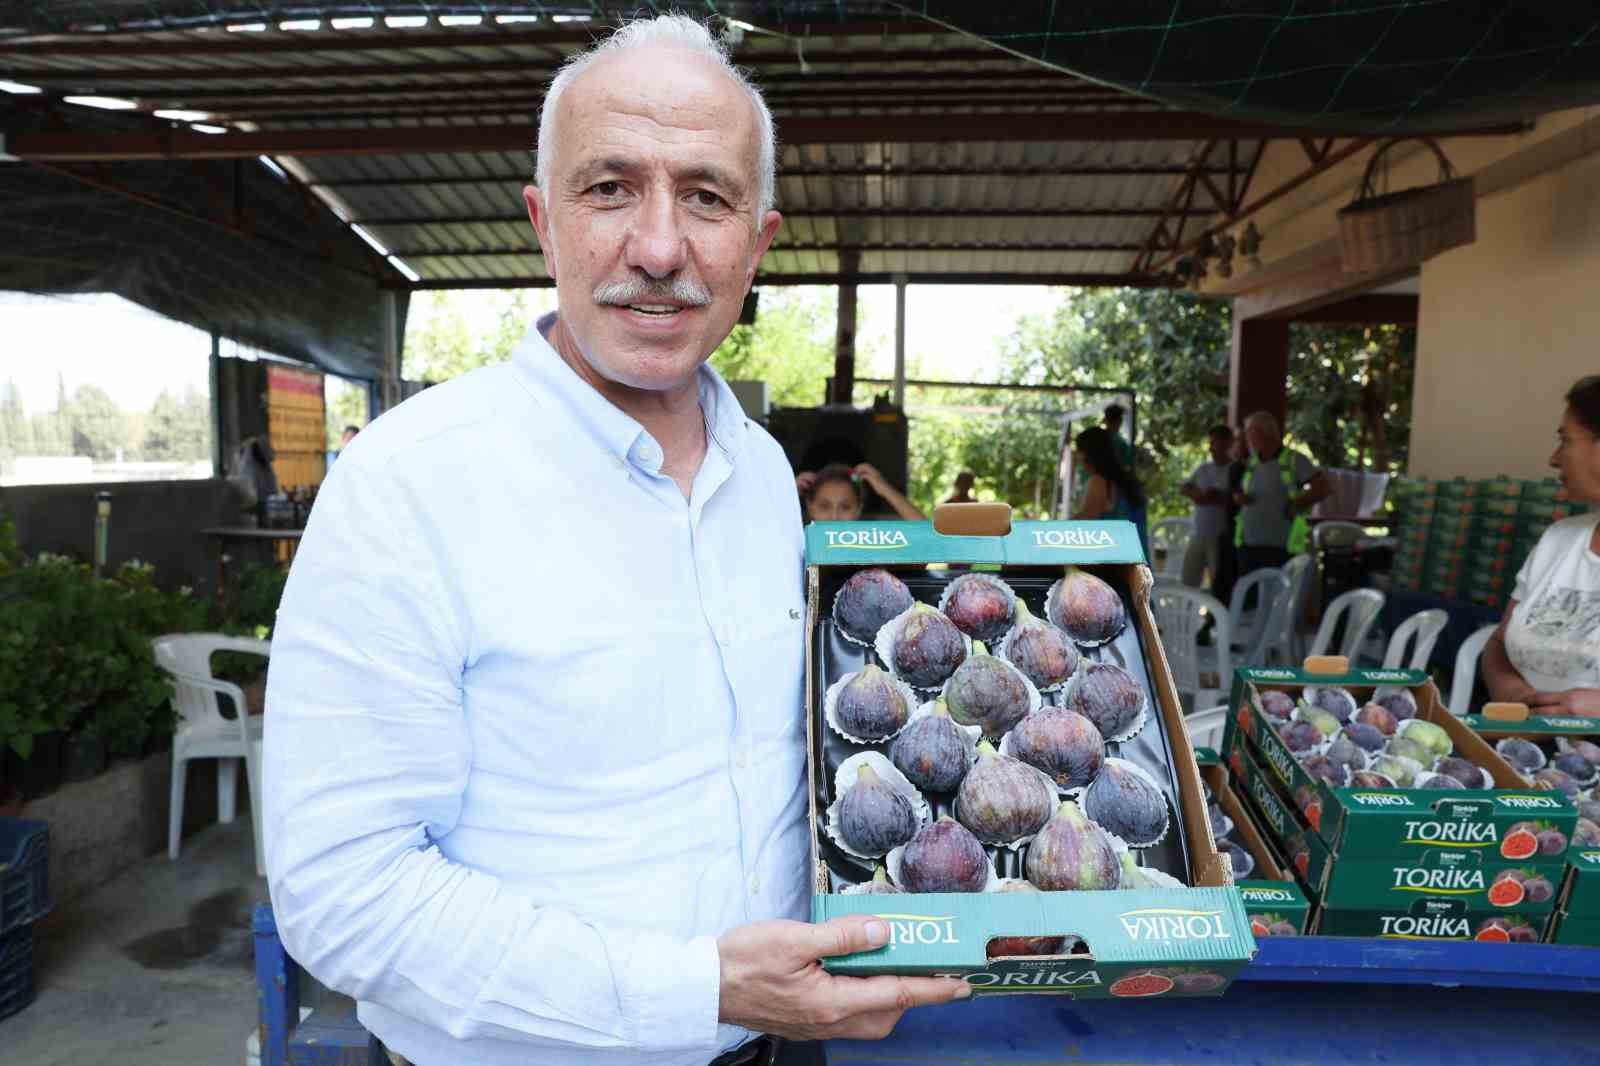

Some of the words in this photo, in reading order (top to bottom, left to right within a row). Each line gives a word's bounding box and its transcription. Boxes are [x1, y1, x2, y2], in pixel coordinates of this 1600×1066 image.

[824, 527, 909, 545] TORİKA
[1032, 527, 1115, 545] TORİKA
[1404, 818, 1498, 842] TORİKA
[1392, 865, 1486, 889] TORİKA
[889, 921, 960, 951] TORİ
[1119, 915, 1232, 945] TORİKA
[1380, 913, 1471, 937] TORİKA
